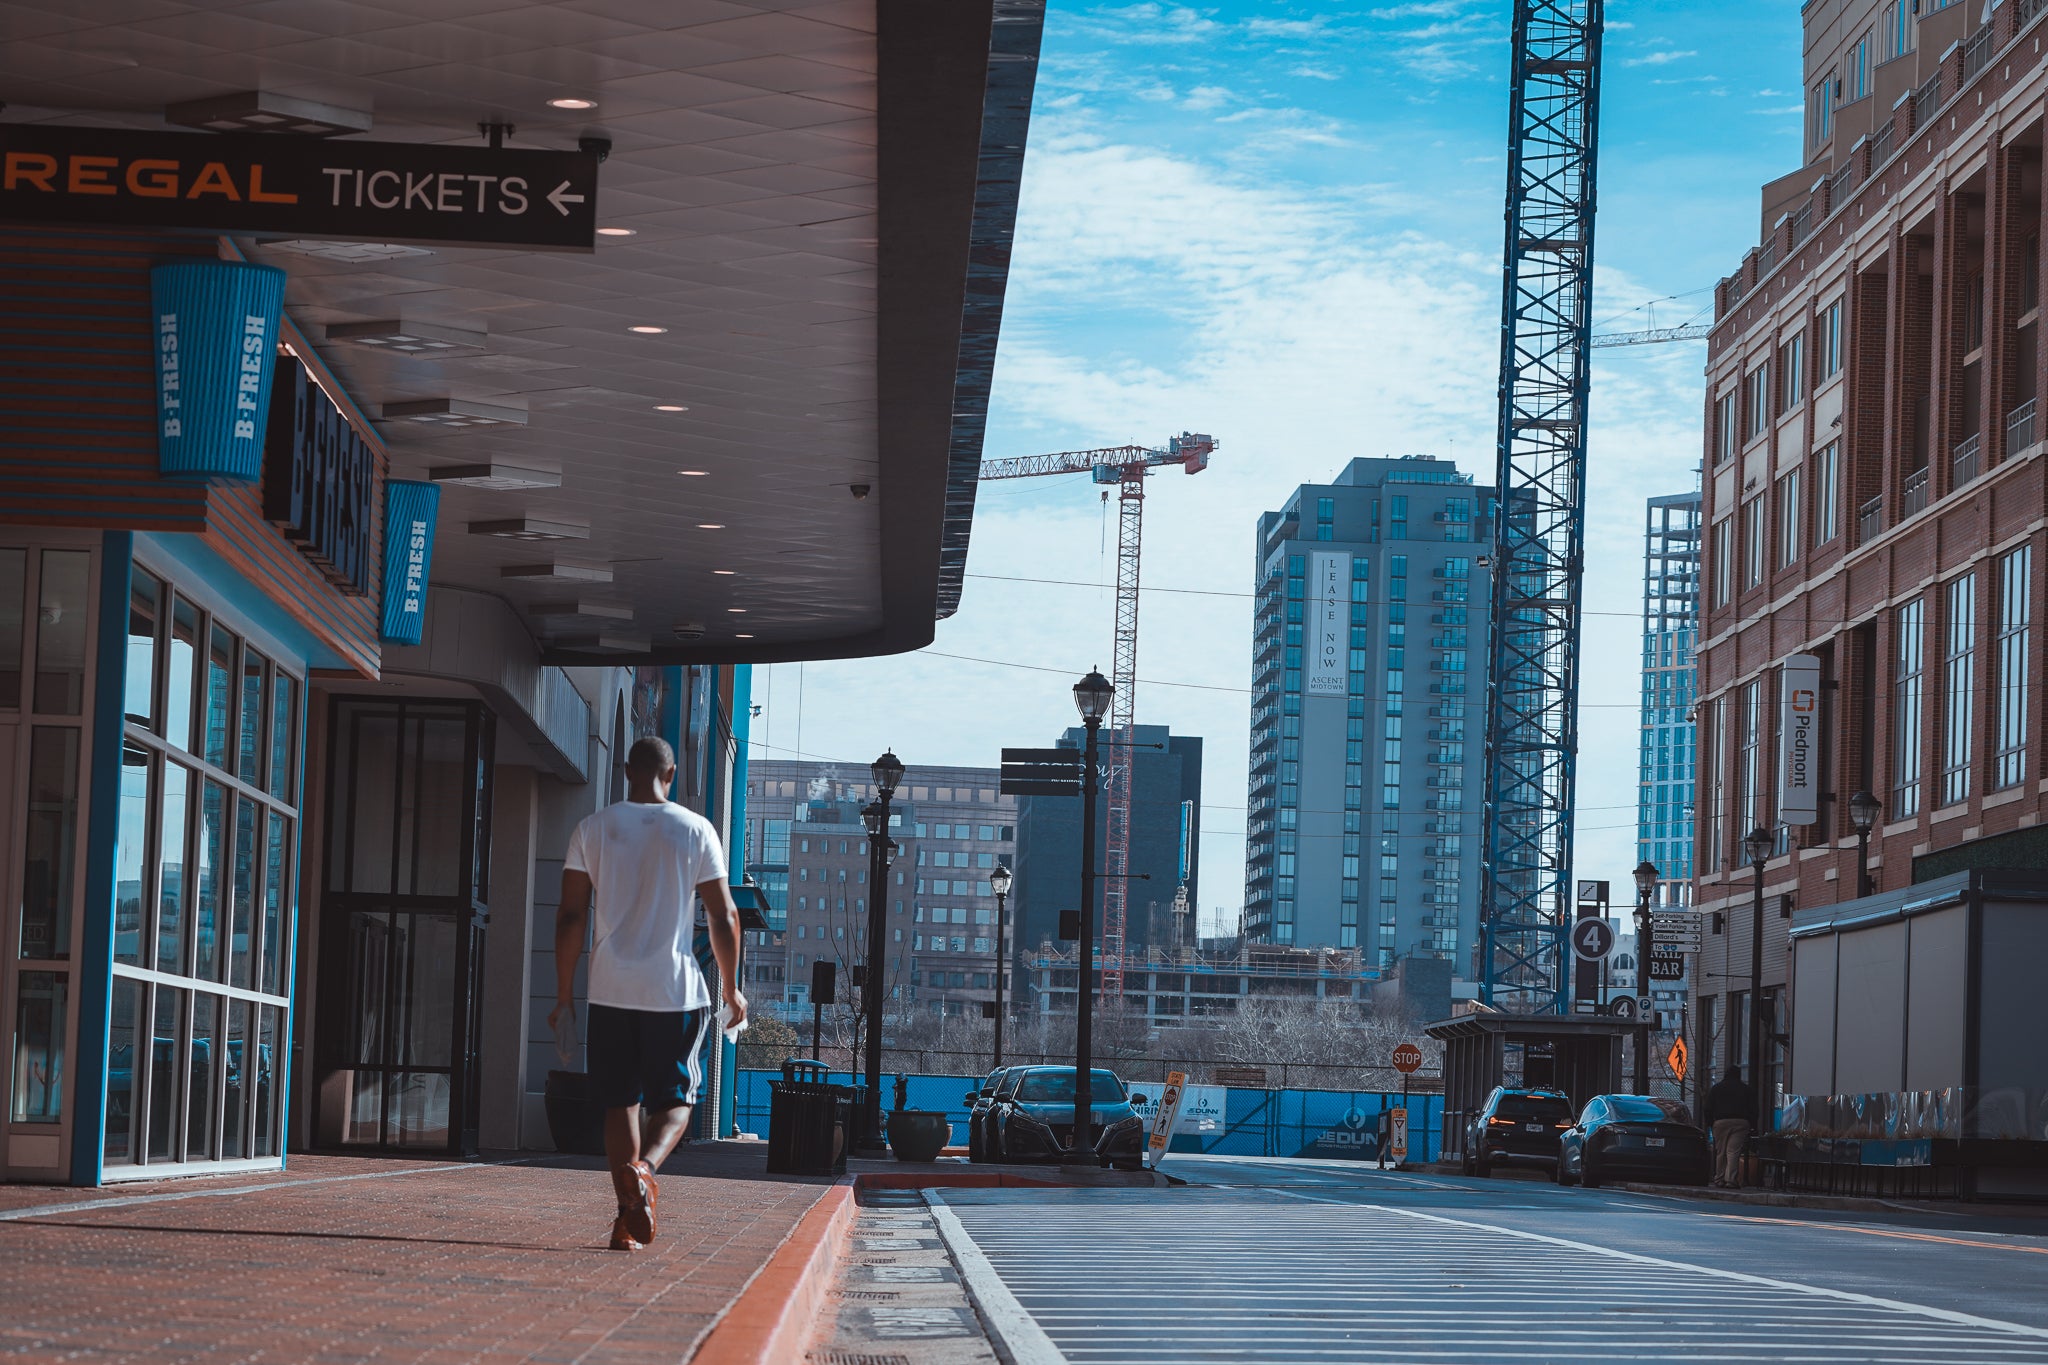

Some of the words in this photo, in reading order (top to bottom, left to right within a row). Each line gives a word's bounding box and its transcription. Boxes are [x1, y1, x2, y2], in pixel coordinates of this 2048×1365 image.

[3, 152, 299, 205] REGAL
[322, 167, 528, 215] TICKETS
[1328, 560, 1336, 619] LEASE
[1324, 634, 1336, 667] NOW
[1312, 677, 1344, 685] ASCENT
[1795, 716, 1809, 787] Piedmont
[1583, 926, 1600, 952] 4
[1651, 962, 1679, 975] BAR
[1618, 1002, 1629, 1017] 4
[1394, 1053, 1420, 1064] STOP
